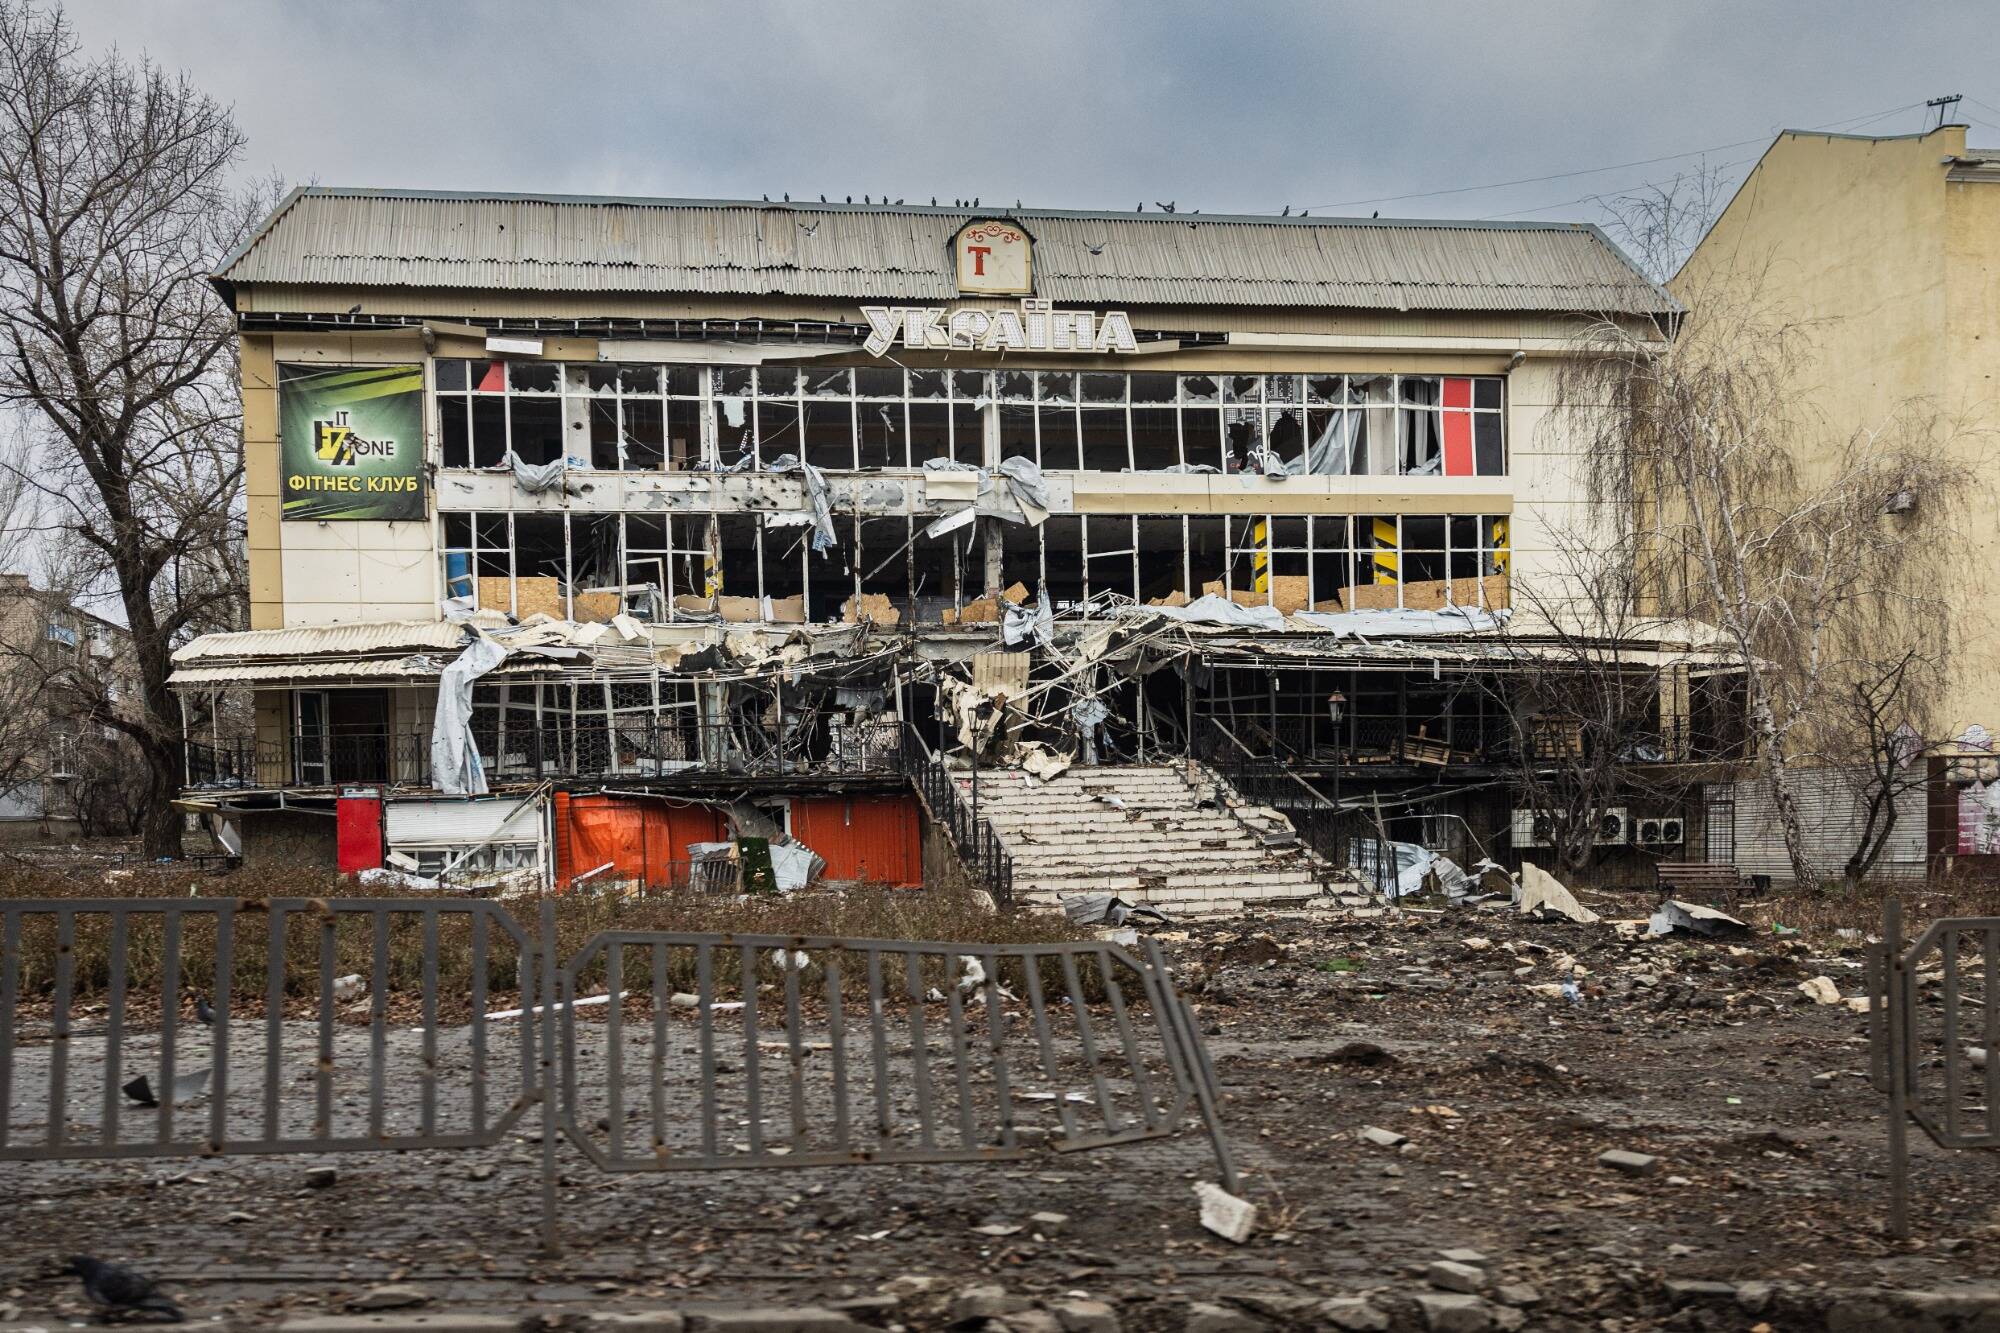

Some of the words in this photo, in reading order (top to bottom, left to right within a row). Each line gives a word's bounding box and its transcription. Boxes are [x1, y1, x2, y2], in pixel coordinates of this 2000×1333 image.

[860, 298, 1140, 358] УКРАЇНА
[289, 474, 361, 492] ФІТНЕС
[368, 476, 418, 492] КЛУБ
